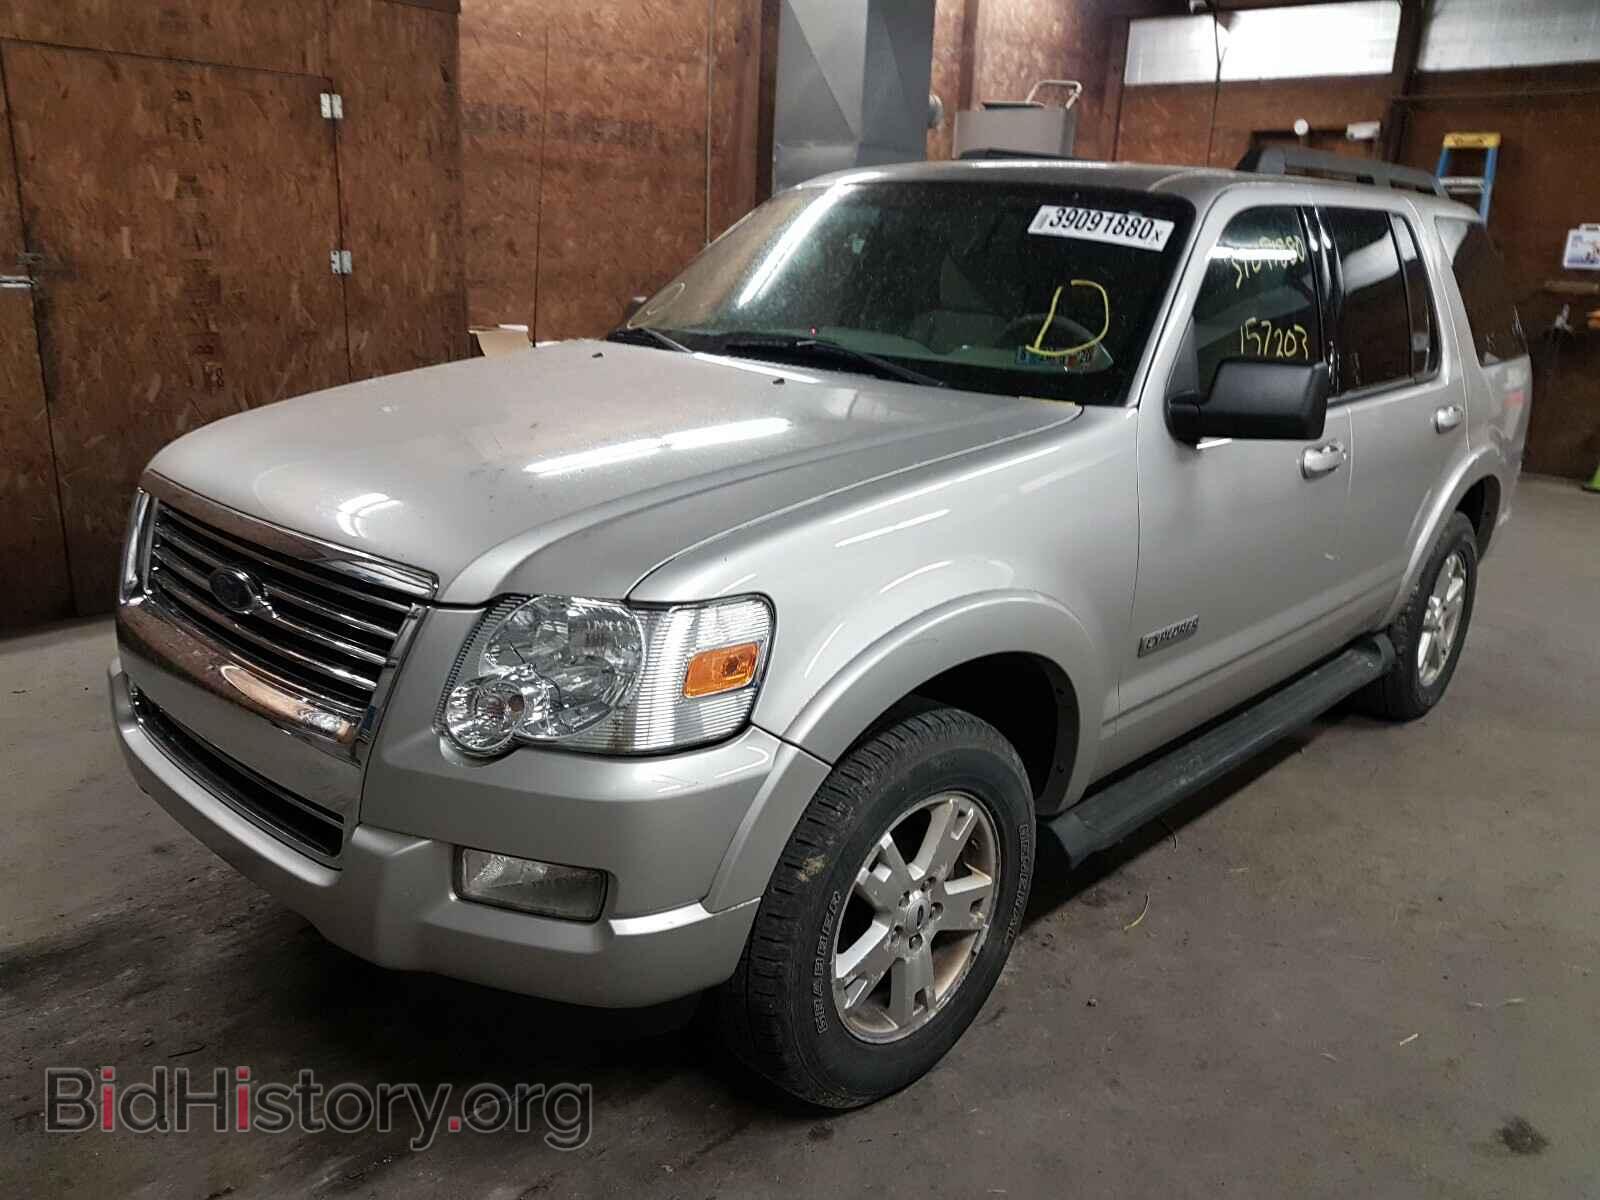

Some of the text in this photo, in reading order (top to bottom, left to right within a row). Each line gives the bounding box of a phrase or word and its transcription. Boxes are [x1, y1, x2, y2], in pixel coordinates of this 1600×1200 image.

[1050, 207, 1156, 241] 39091880
[1240, 317, 1309, 361] 157203
[812, 890, 841, 1034] GRABBER
